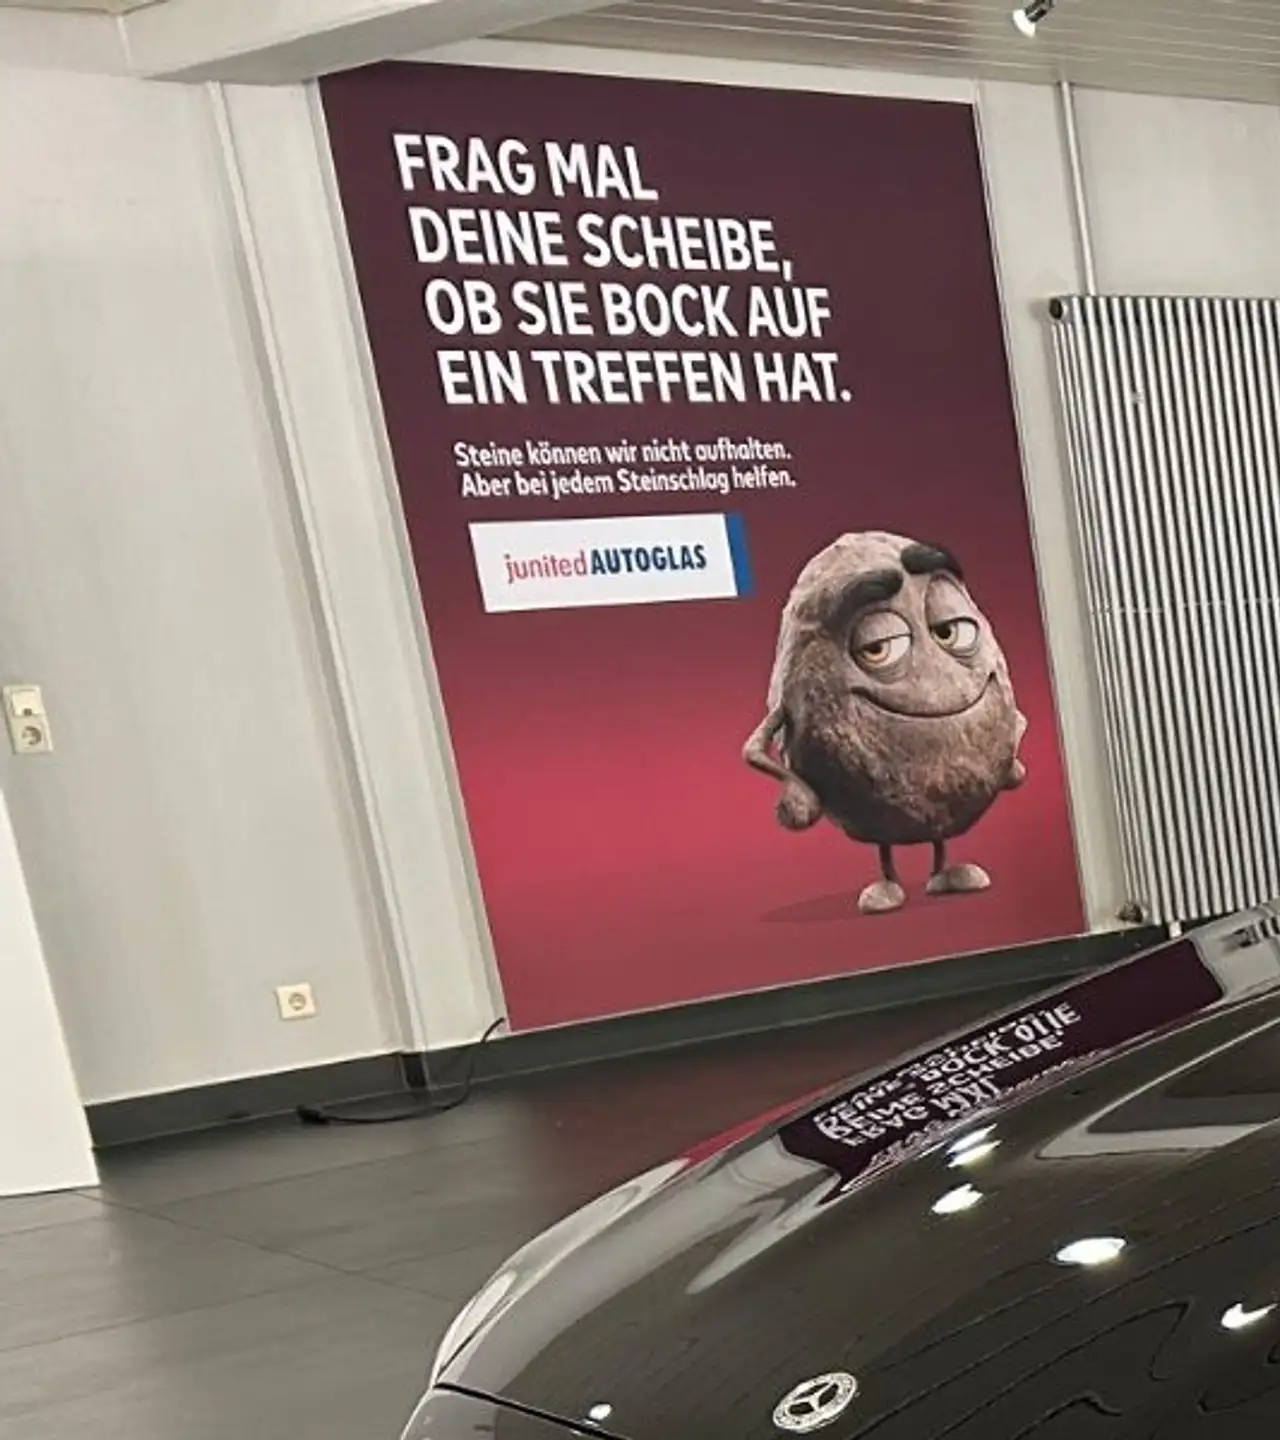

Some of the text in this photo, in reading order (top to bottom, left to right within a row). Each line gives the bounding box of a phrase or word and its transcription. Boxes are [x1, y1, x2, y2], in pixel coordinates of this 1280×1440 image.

[392, 132, 660, 201] FRAG MAL
[406, 205, 793, 282] DEINE SCHEIBE,
[424, 278, 832, 338] OB SIE BOCK AUF
[436, 350, 853, 405] EIN TREFFEN HAT.
[453, 435, 793, 468] Steine können wir nicht aufhalten.
[461, 463, 798, 501] Aber bei jedem Steinschlag helfen.
